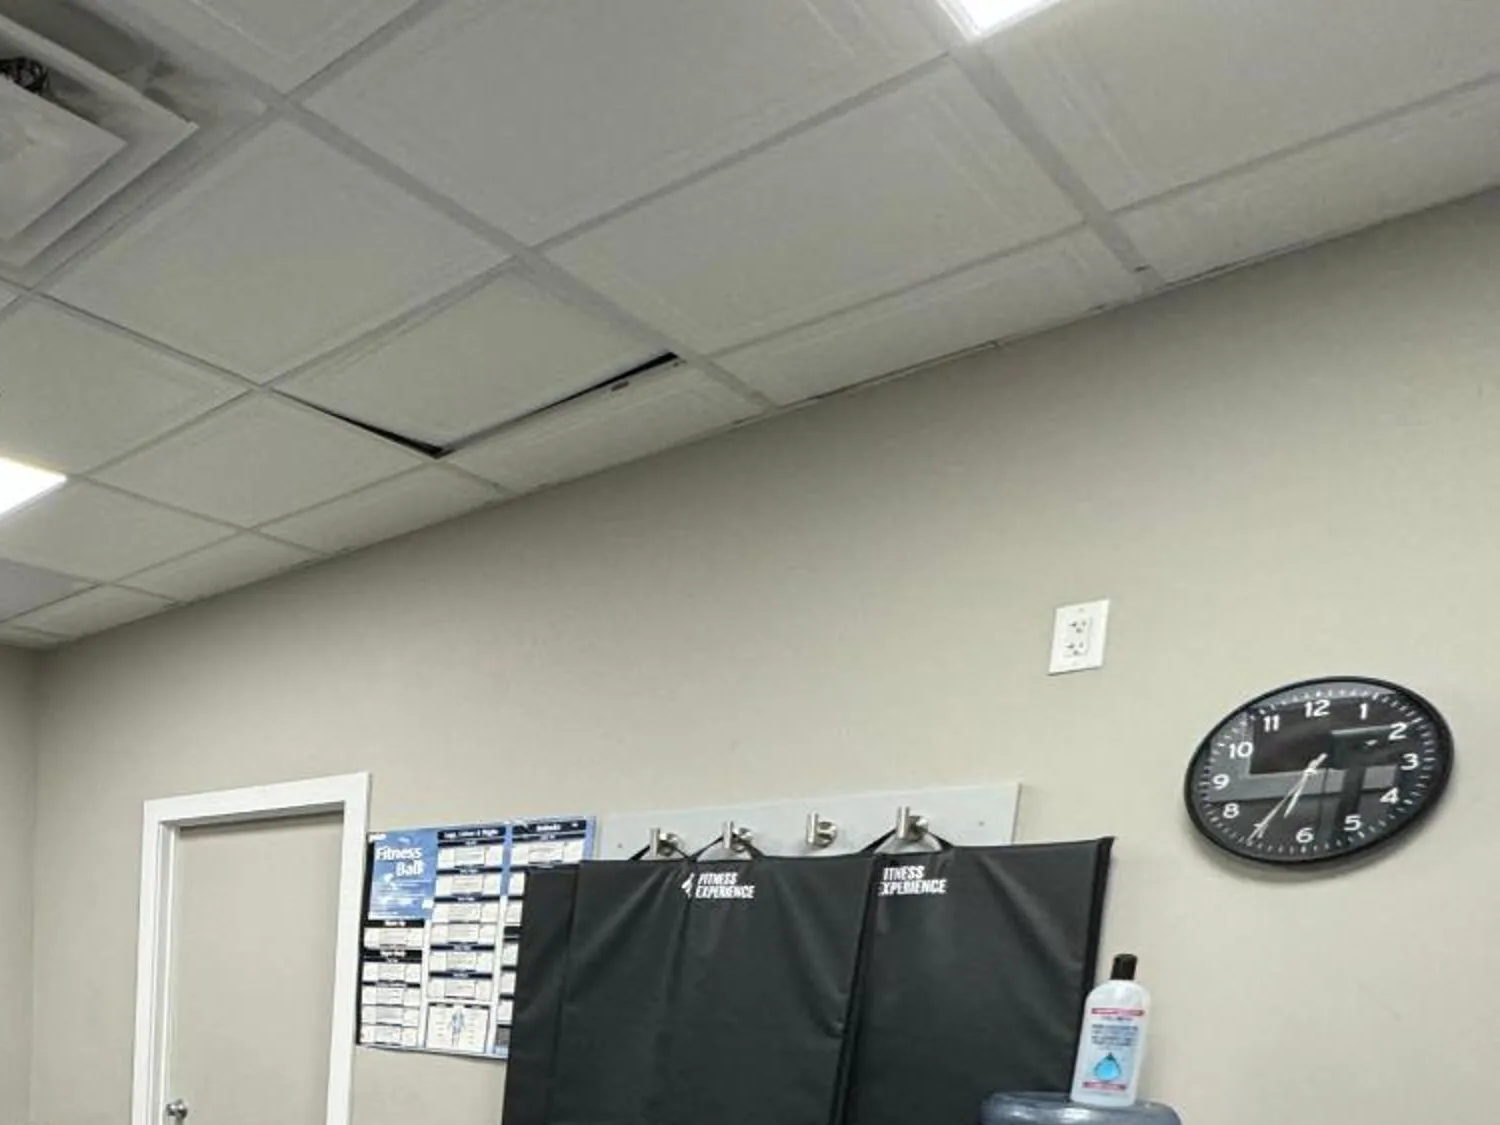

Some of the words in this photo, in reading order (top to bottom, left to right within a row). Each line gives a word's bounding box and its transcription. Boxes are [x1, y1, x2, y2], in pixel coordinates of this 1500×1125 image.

[1304, 699, 1330, 718] 12
[1359, 703, 1368, 719] 1
[1263, 714, 1280, 732] 11
[1388, 722, 1407, 740] 2
[1229, 741, 1254, 759] 10
[1400, 753, 1419, 771] 3
[1213, 774, 1230, 789] 9
[1380, 787, 1399, 804] 4
[1223, 803, 1239, 819] 8
[1343, 814, 1361, 831] 5
[1296, 827, 1314, 844] 6
[375, 846, 423, 860] Fitness
[395, 860, 425, 877] Ball
[883, 865, 926, 881] ITNESS
[698, 872, 738, 885] FITNESS
[695, 885, 755, 899] EXPERIENCE
